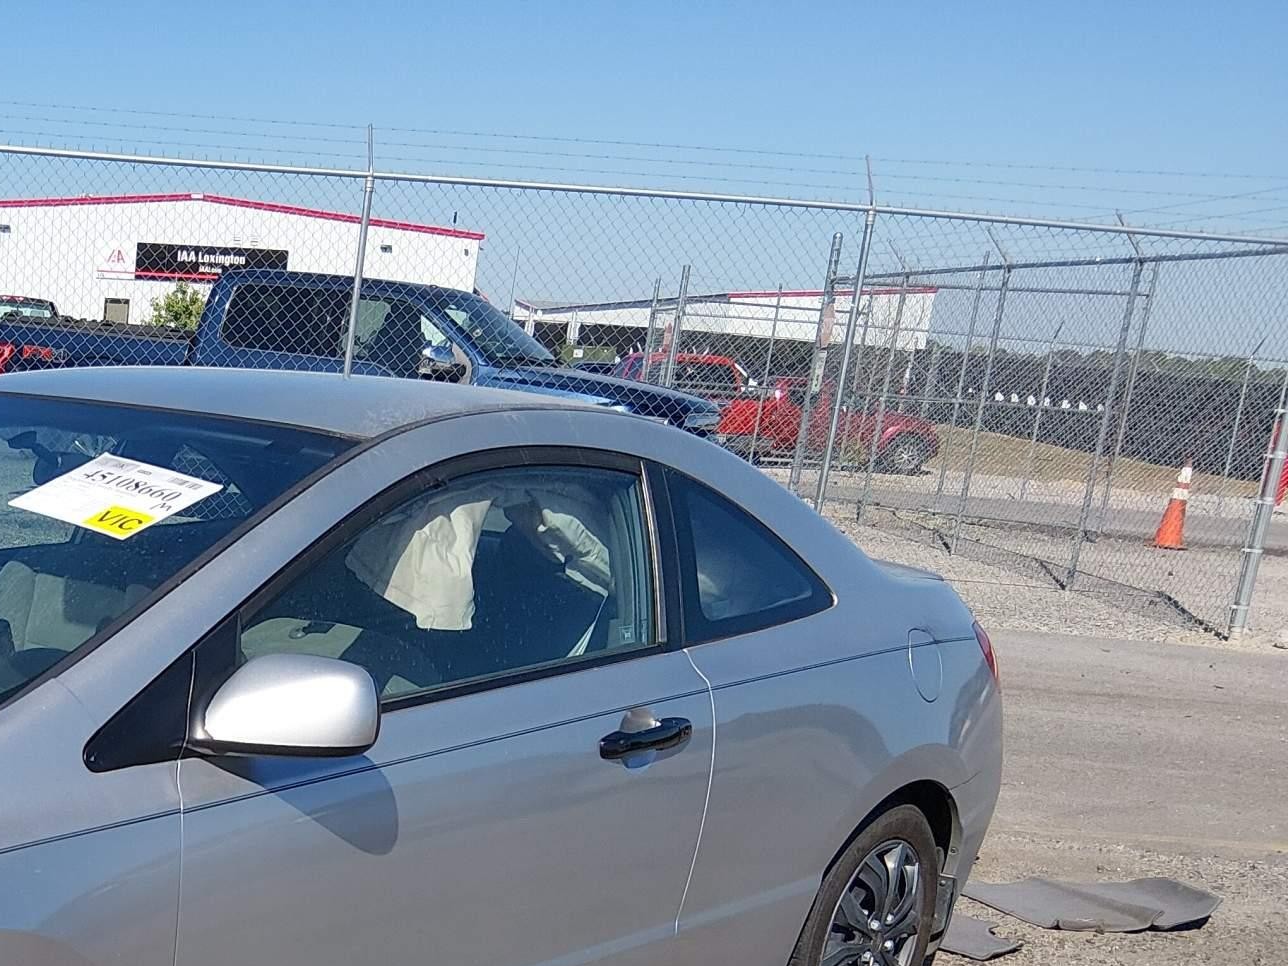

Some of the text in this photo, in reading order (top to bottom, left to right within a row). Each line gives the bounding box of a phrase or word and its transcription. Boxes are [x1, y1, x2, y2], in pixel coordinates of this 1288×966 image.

[177, 250, 246, 266] IAA Lexington
[83, 469, 182, 501] 45108660
[98, 510, 143, 530] VIC
